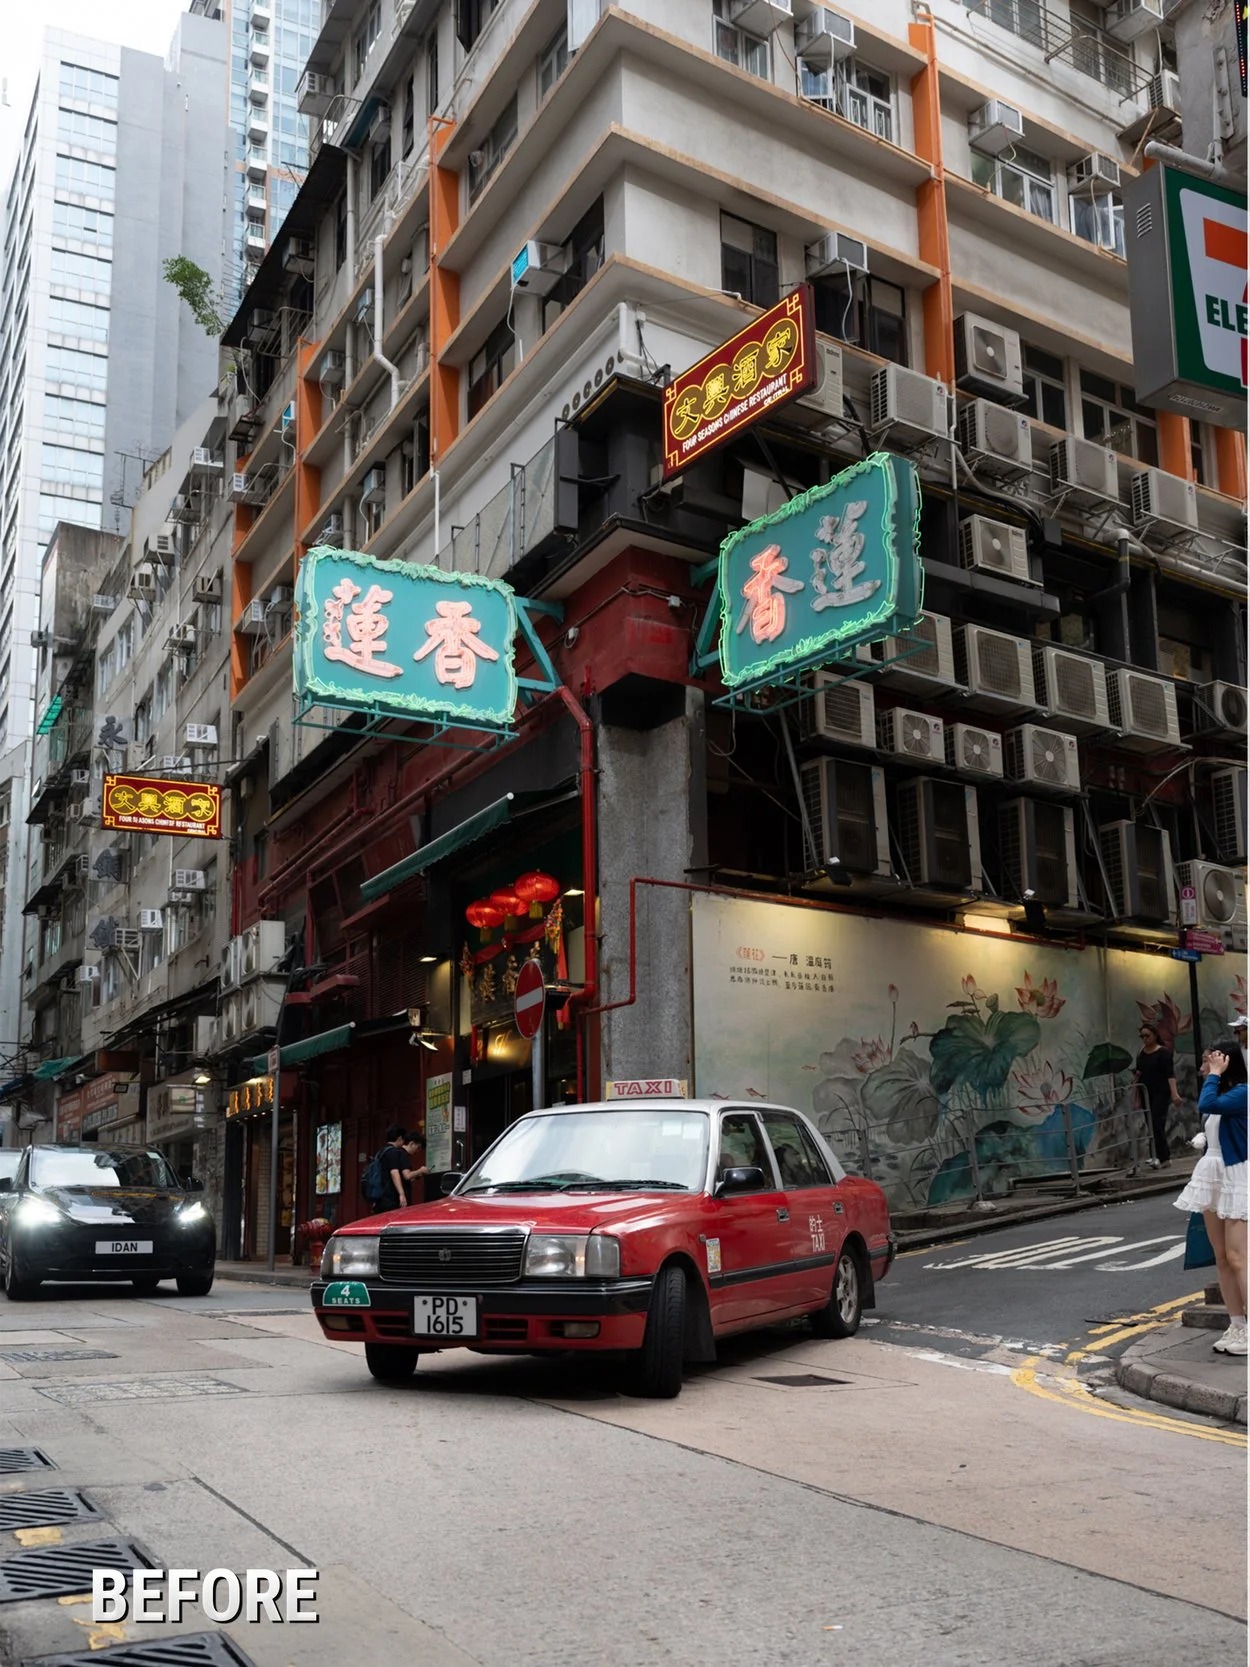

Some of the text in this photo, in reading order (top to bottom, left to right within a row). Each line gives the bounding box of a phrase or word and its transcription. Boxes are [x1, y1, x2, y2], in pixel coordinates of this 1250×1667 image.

[682, 373, 787, 453] FOUR SEASONS CHINESE RESTAURANT
[324, 578, 499, 689] 蓮香
[614, 1080, 672, 1096] TAXI
[808, 1214, 823, 1233] 的士
[811, 1233, 826, 1253] TAXI
[340, 1284, 350, 1297] 4
[331, 1297, 361, 1305] SEATS
[432, 1297, 459, 1316] PD
[427, 1315, 464, 1335] 1615
